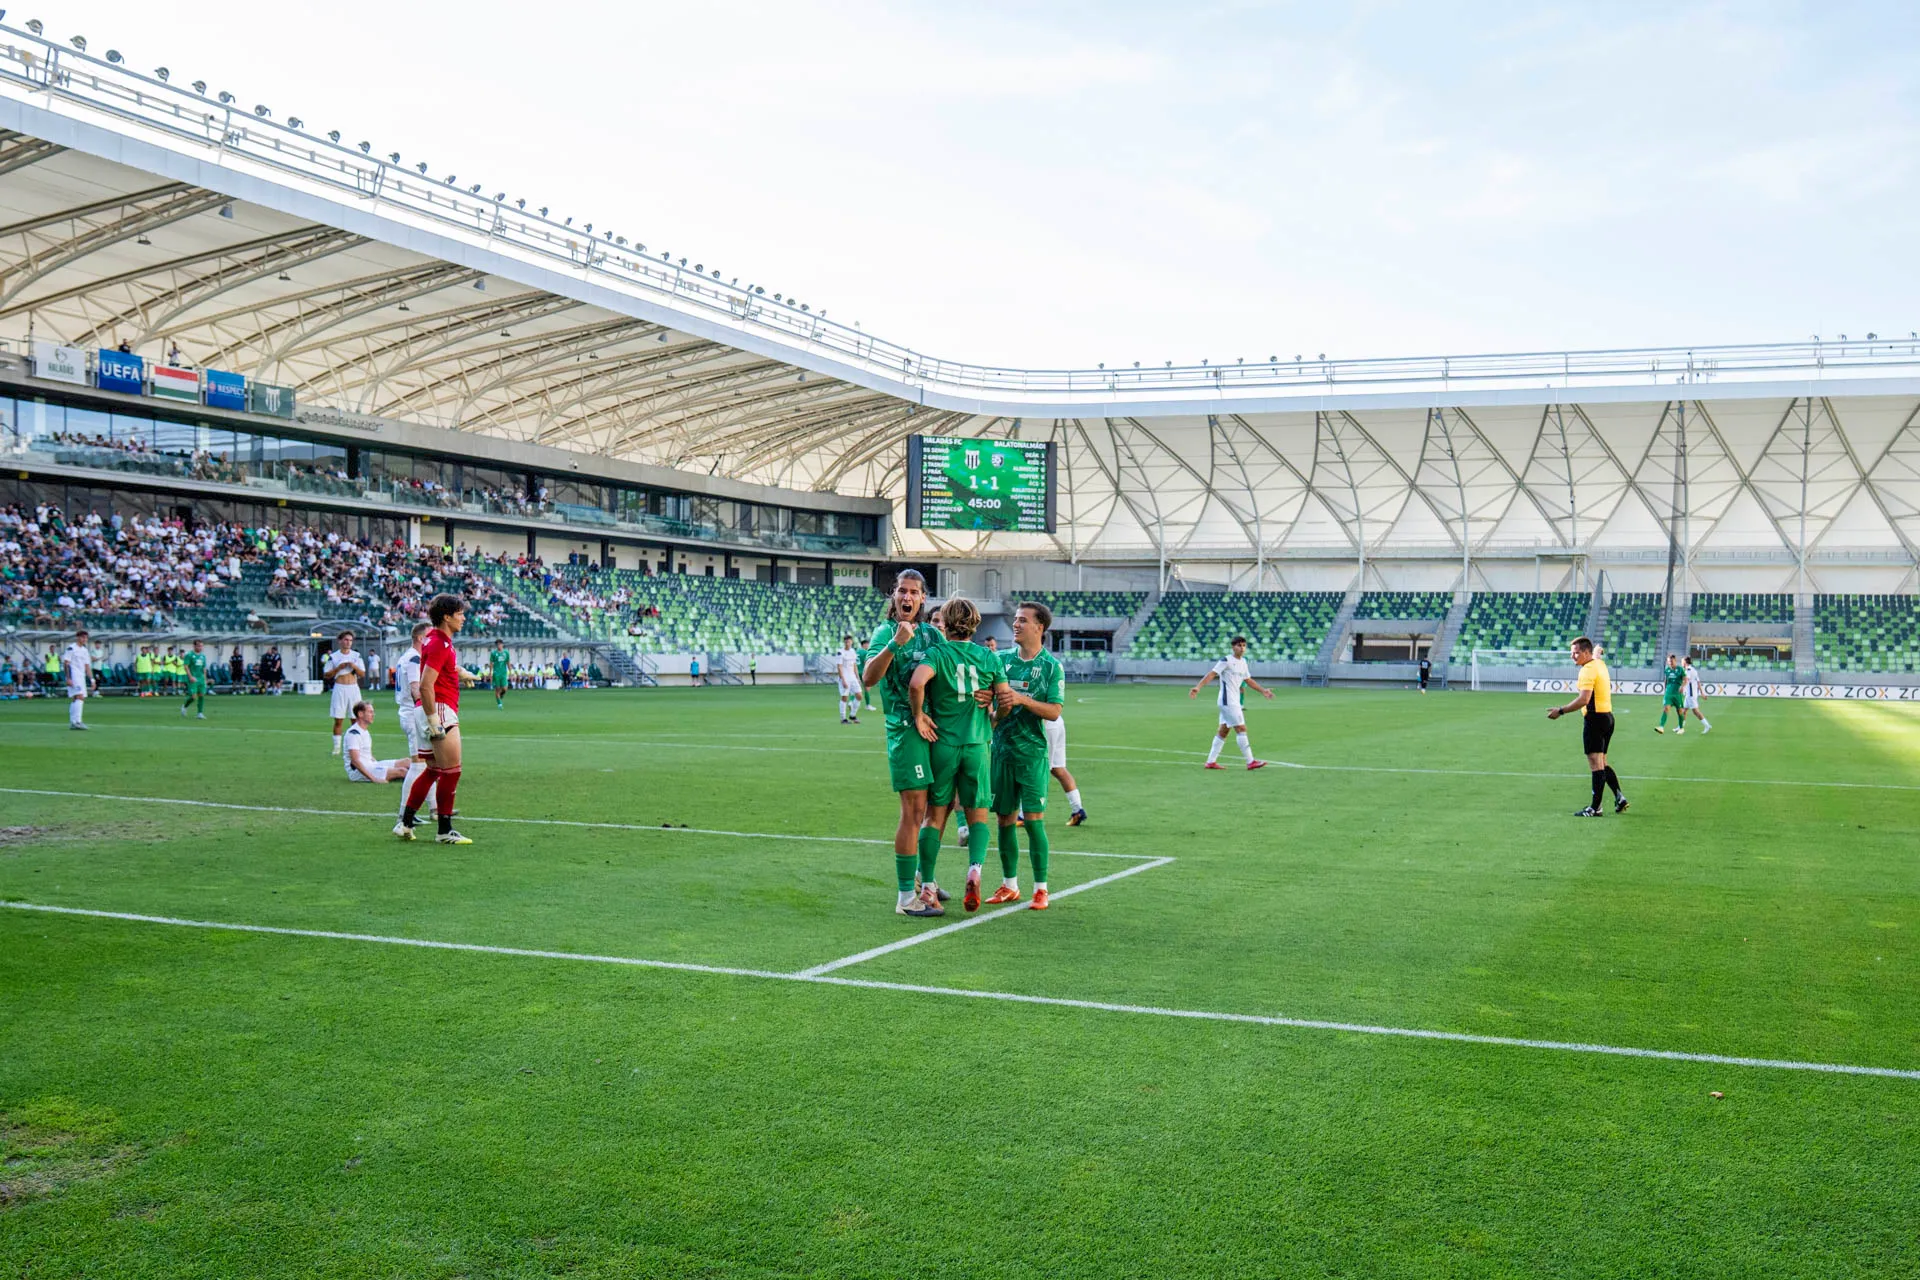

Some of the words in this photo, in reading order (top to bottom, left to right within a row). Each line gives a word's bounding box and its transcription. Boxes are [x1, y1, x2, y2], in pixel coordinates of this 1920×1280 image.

[101, 361, 140, 382] UEFA
[923, 437, 953, 445] HALADÁS
[968, 475, 979, 489] 1
[990, 476, 999, 490] 1
[967, 498, 1002, 509] 45:00
[955, 663, 980, 702] 11
[914, 764, 925, 779] 9
